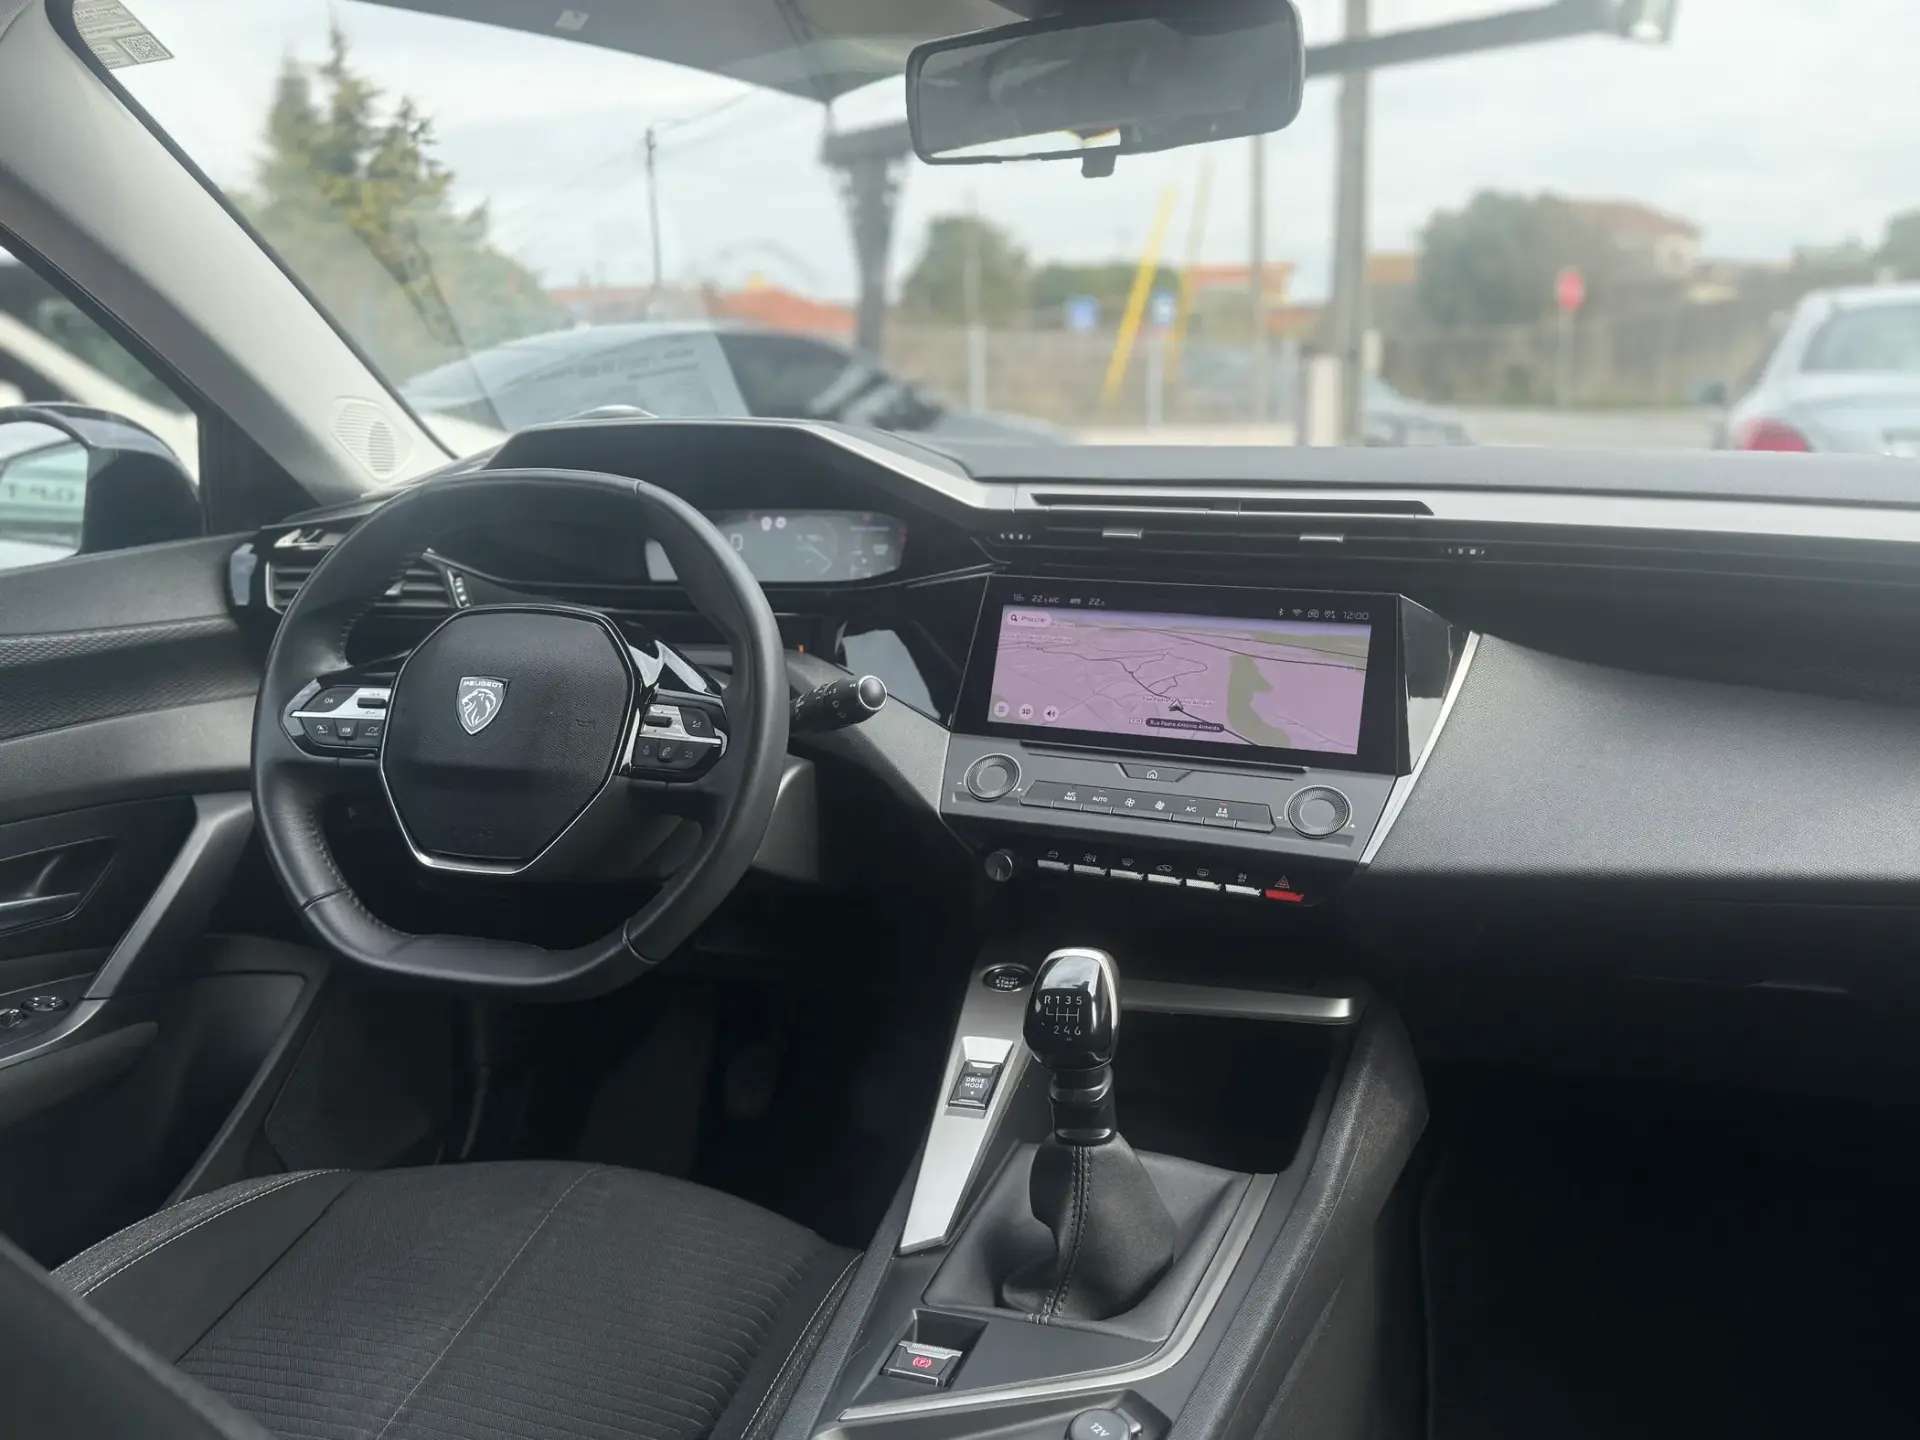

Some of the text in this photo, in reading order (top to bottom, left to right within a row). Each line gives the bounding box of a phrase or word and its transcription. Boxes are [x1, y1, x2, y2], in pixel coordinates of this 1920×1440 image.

[1342, 610, 1369, 620] 12:00
[462, 680, 504, 688] PEUGEOT
[1198, 723, 1220, 731] Almeida
[1044, 995, 1051, 1004] R
[1064, 995, 1072, 1005] 3
[1076, 996, 1083, 1005] 5
[1053, 1025, 1081, 1036] 2 4 6
[1089, 1421, 1110, 1438] 12V
